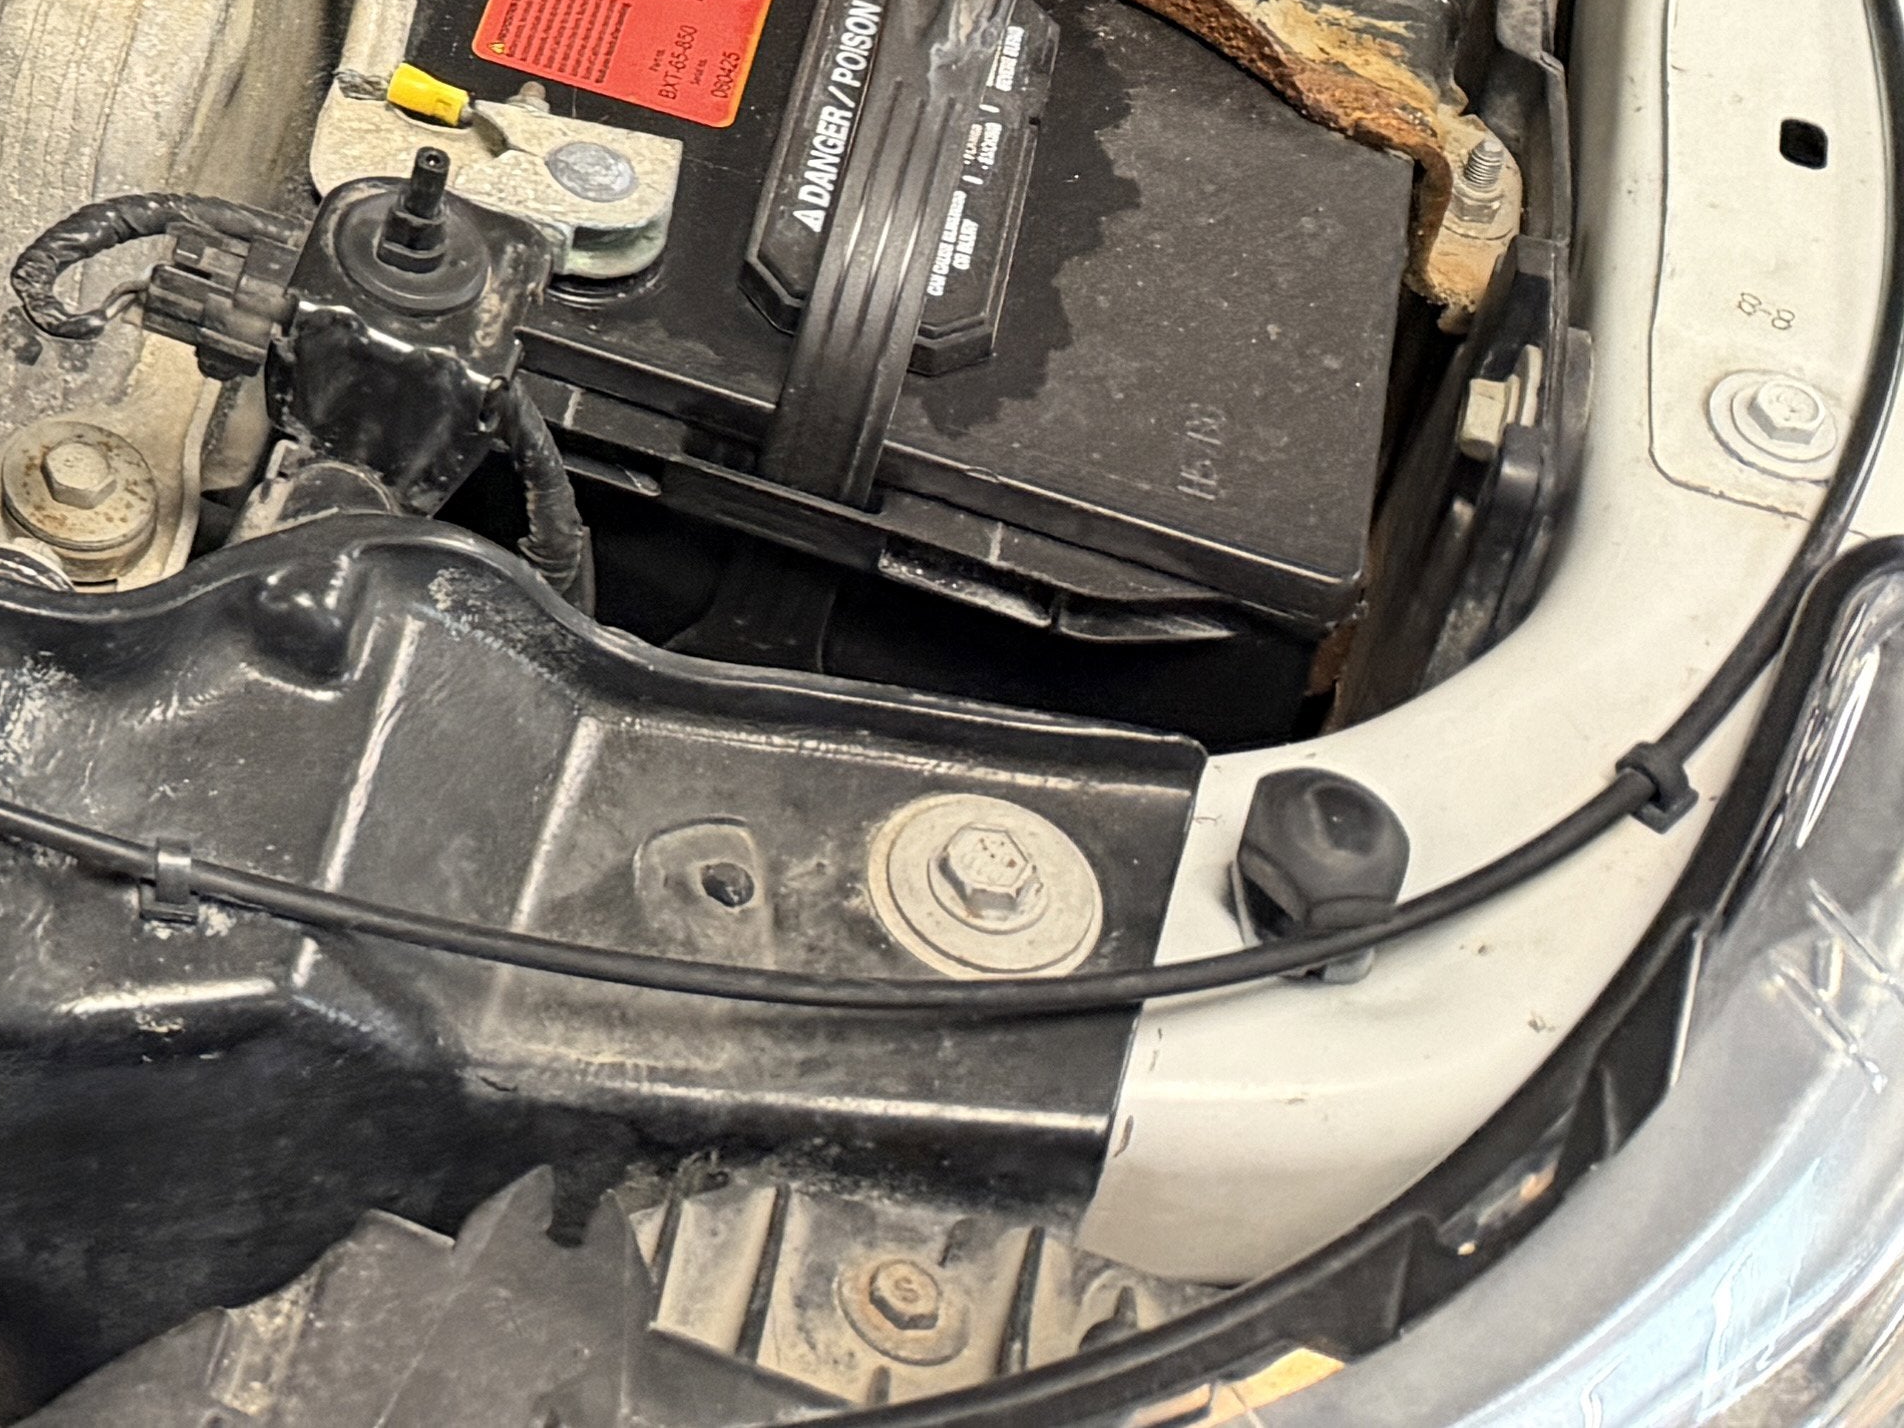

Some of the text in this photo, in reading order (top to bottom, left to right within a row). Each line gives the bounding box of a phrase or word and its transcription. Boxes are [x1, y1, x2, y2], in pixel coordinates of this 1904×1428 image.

[658, 24, 698, 101] BXT-65-850
[797, 104, 854, 208] DANGER
[827, 84, 856, 110] /
